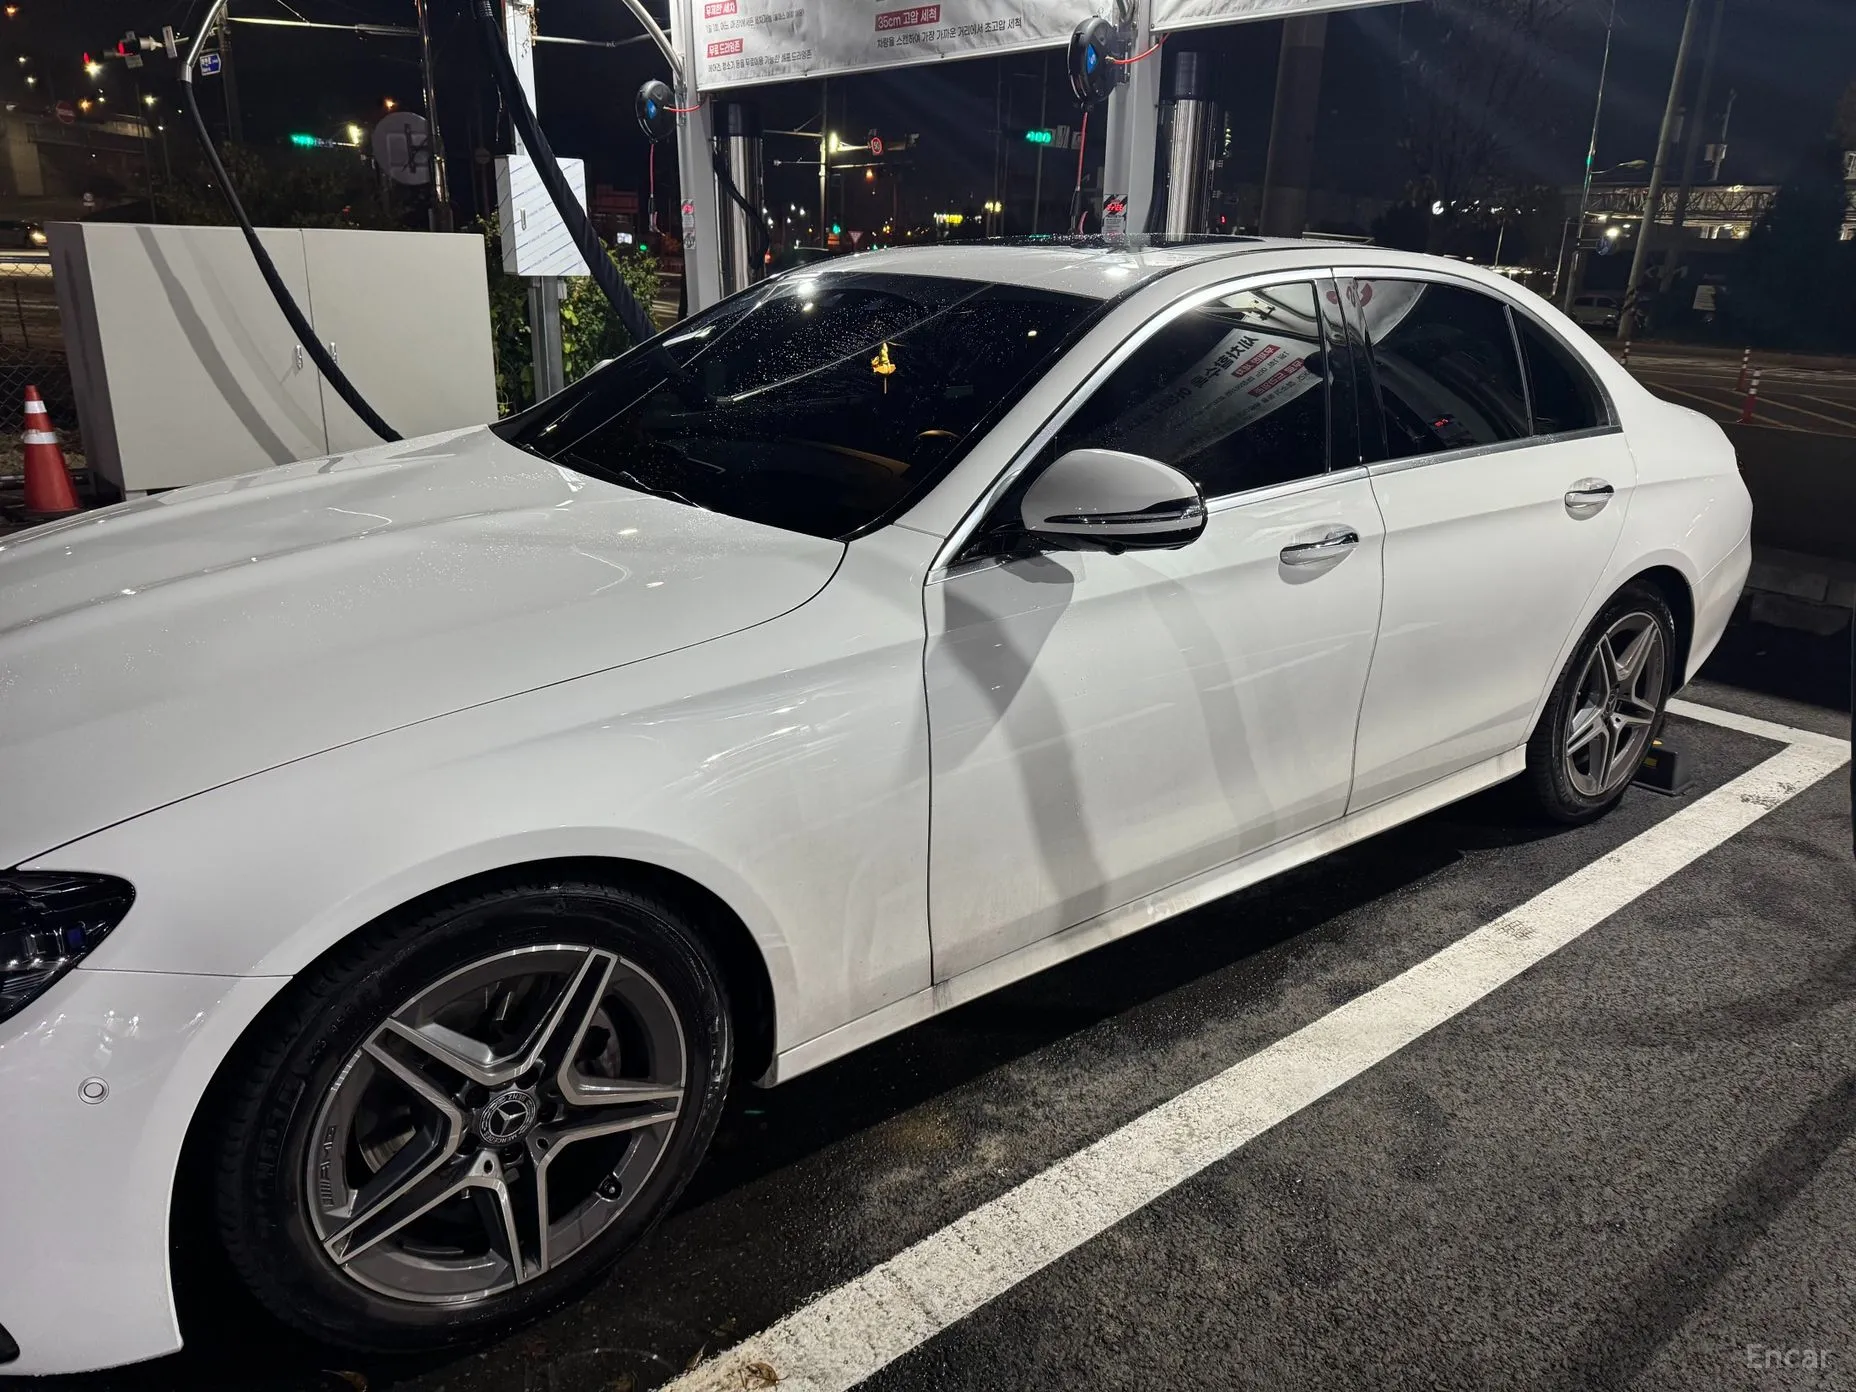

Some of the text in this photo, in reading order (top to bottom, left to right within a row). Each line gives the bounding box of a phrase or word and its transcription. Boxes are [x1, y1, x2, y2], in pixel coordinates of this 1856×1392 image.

[878, 7, 937, 29] 35cm 고압 세척
[877, 17, 1022, 49] 차량을 스캔하여 가장 가까운 거리에서 초고압 세척
